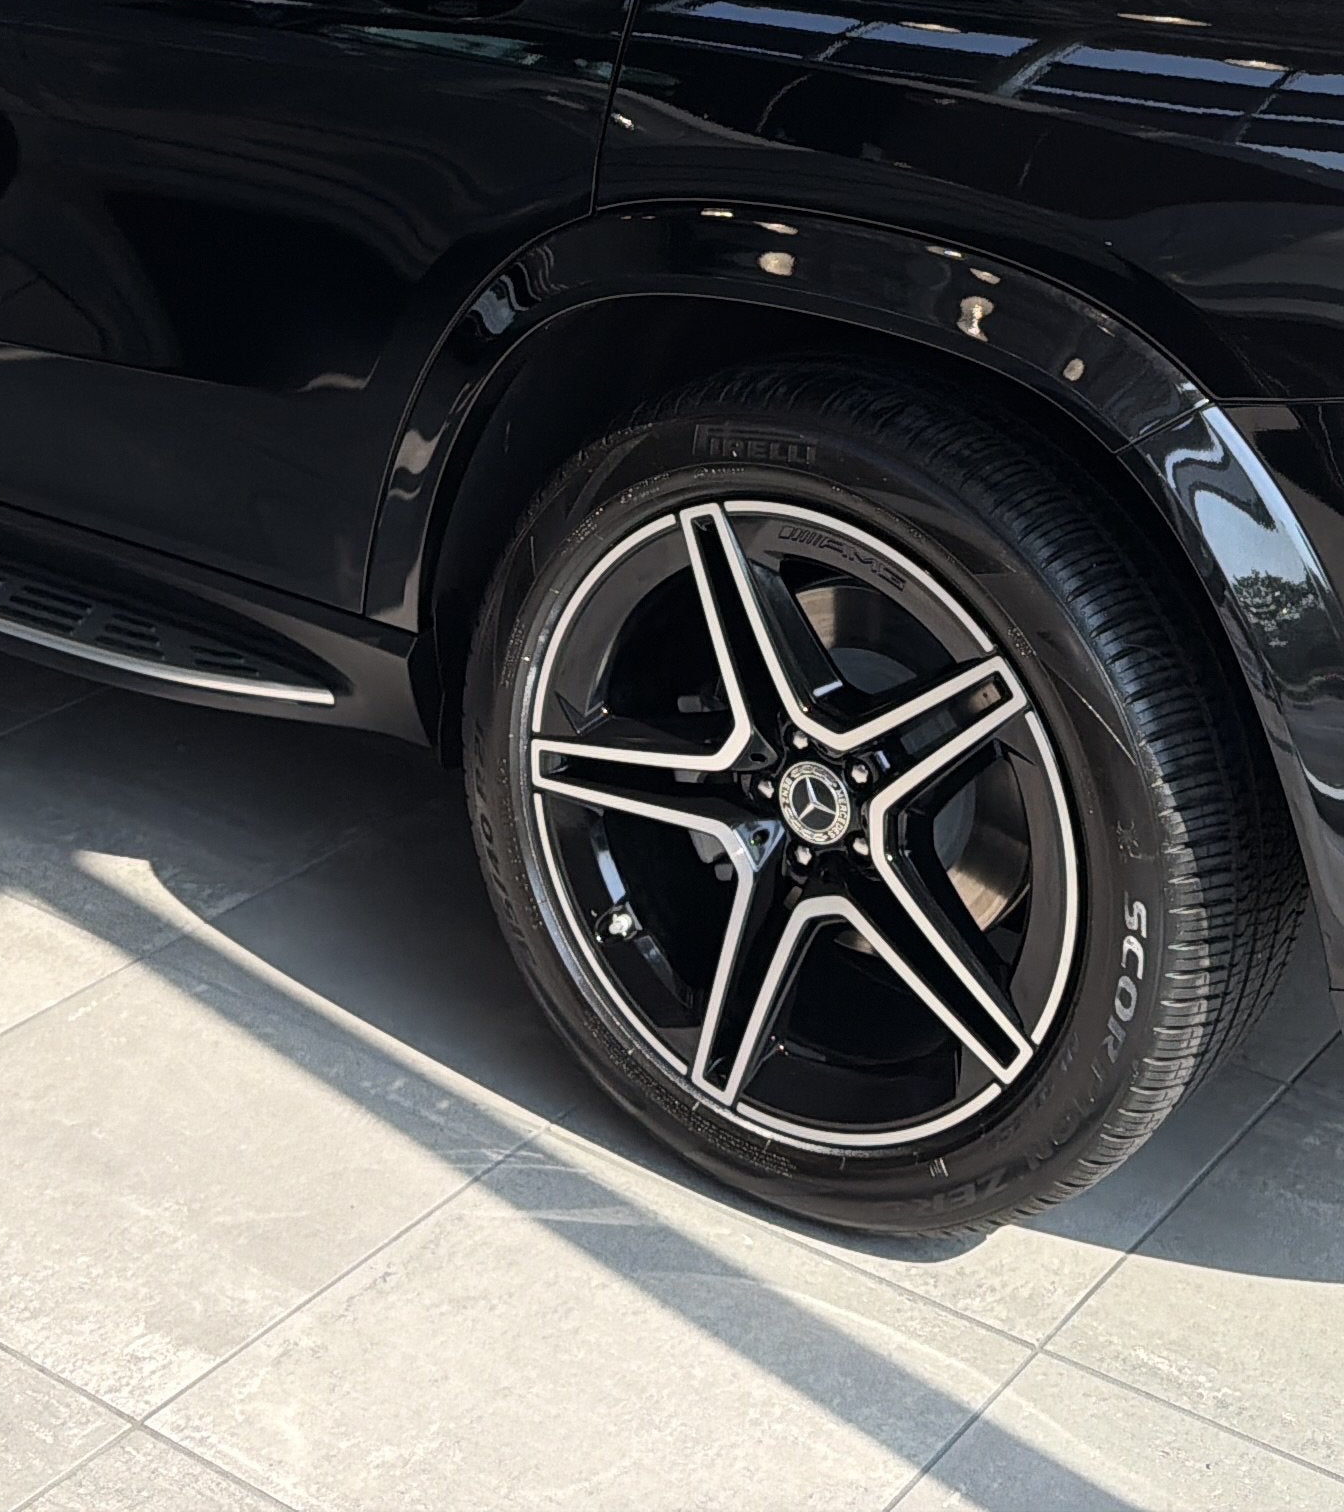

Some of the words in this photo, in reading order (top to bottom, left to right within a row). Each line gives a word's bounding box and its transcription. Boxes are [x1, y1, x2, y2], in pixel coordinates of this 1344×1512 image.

[692, 424, 818, 466] PIRELLI
[781, 776, 794, 805] BENZ
[827, 788, 849, 840] MERCEDES
